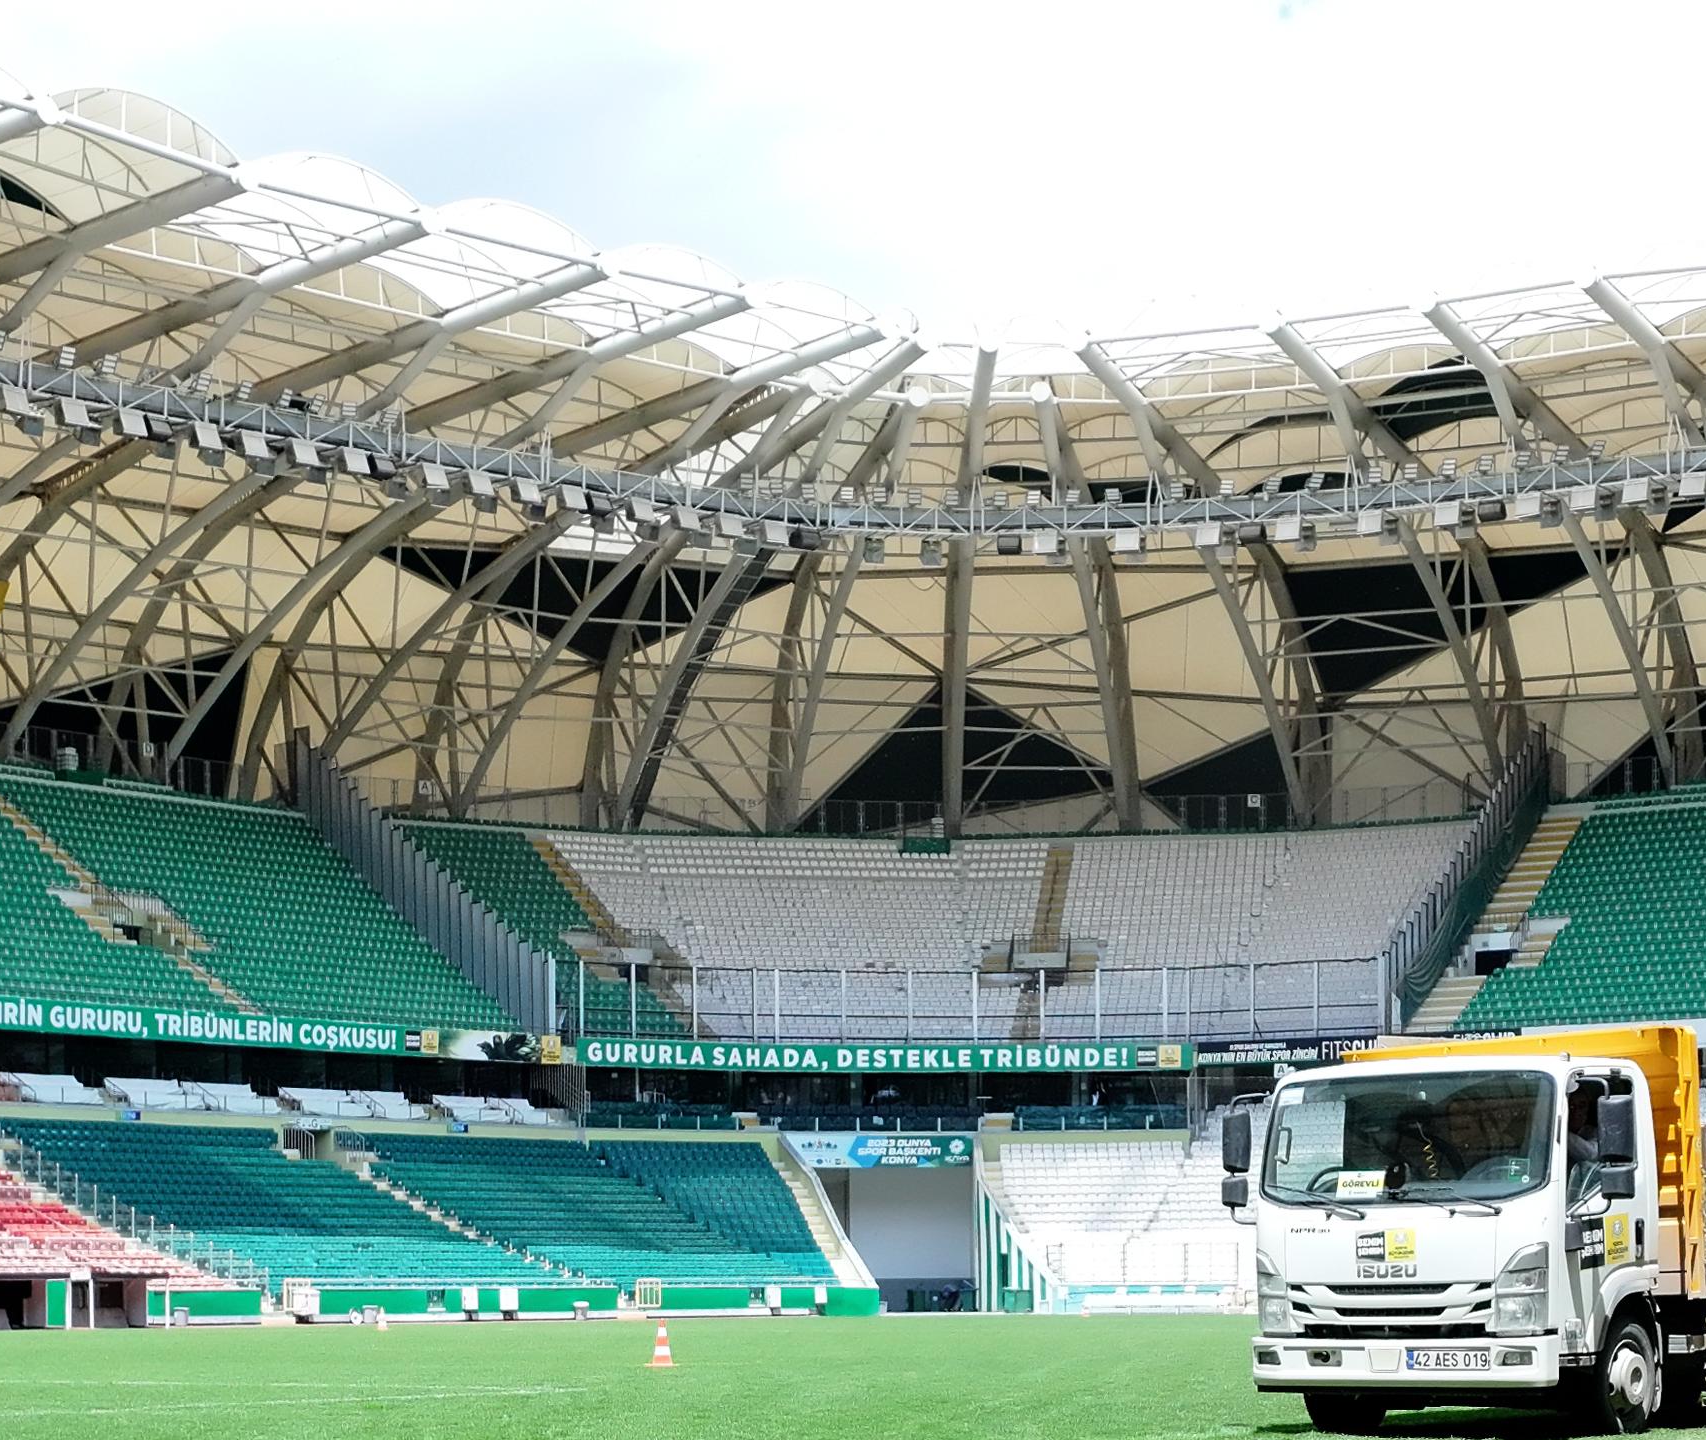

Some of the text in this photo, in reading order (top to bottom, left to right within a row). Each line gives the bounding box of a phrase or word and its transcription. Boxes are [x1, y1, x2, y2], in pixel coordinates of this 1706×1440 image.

[421, 781, 429, 790] A
[50, 1008, 149, 1038] GURURU,
[155, 1011, 293, 1044] TRİBÜNLERİN
[300, 1023, 397, 1051] COŞKUSU!
[587, 1042, 705, 1066] GURURLA
[712, 1047, 829, 1070] SAHADA,
[836, 1048, 971, 1068] DESTEKLE
[979, 1045, 1128, 1068] TRİBÜNDE!
[1272, 1049, 1291, 1061] SPOR
[1278, 1064, 1285, 1073] A
[880, 1156, 917, 1164] KONYA
[1341, 1179, 1380, 1189] GÖREVLİ
[1357, 1264, 1417, 1279] ISUZU
[1414, 1352, 1488, 1368] 42 AES 019
